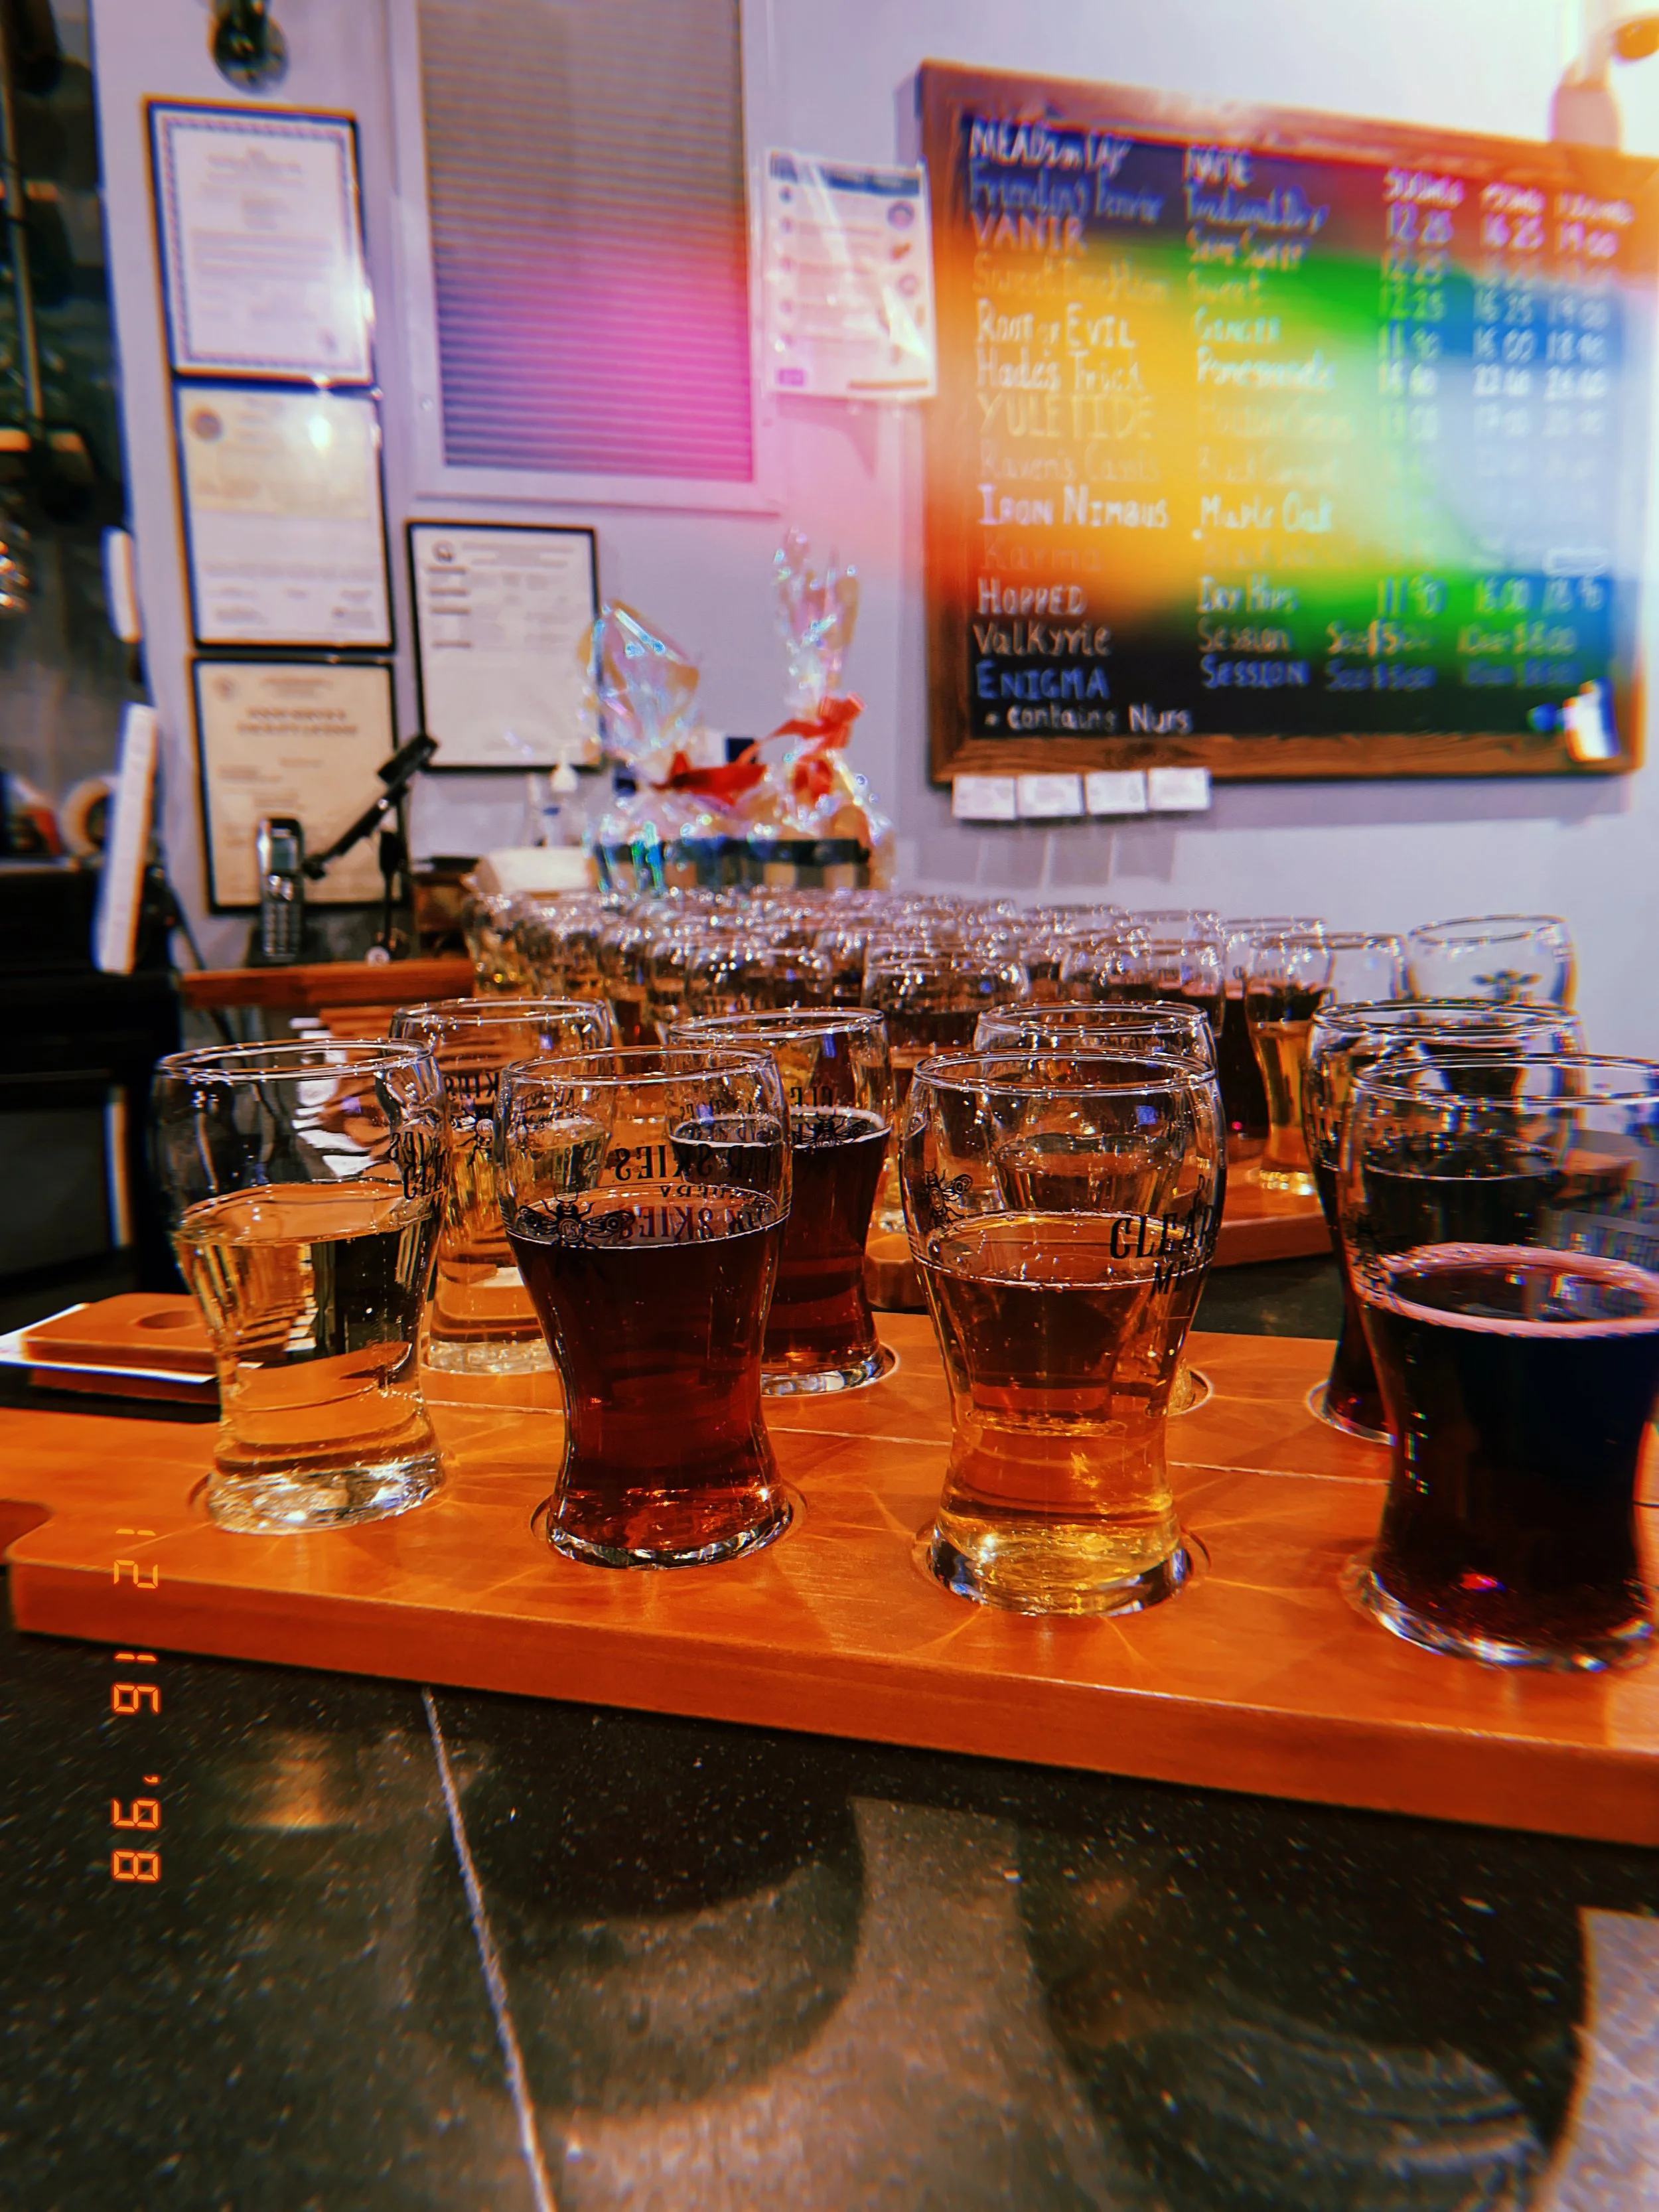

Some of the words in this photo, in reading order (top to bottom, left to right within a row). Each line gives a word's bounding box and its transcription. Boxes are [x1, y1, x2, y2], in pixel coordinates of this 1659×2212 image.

[972, 211, 1088, 256] VANIR
[976, 390, 1156, 439] YULETIDE
[976, 660, 1111, 700] ENIGMA
